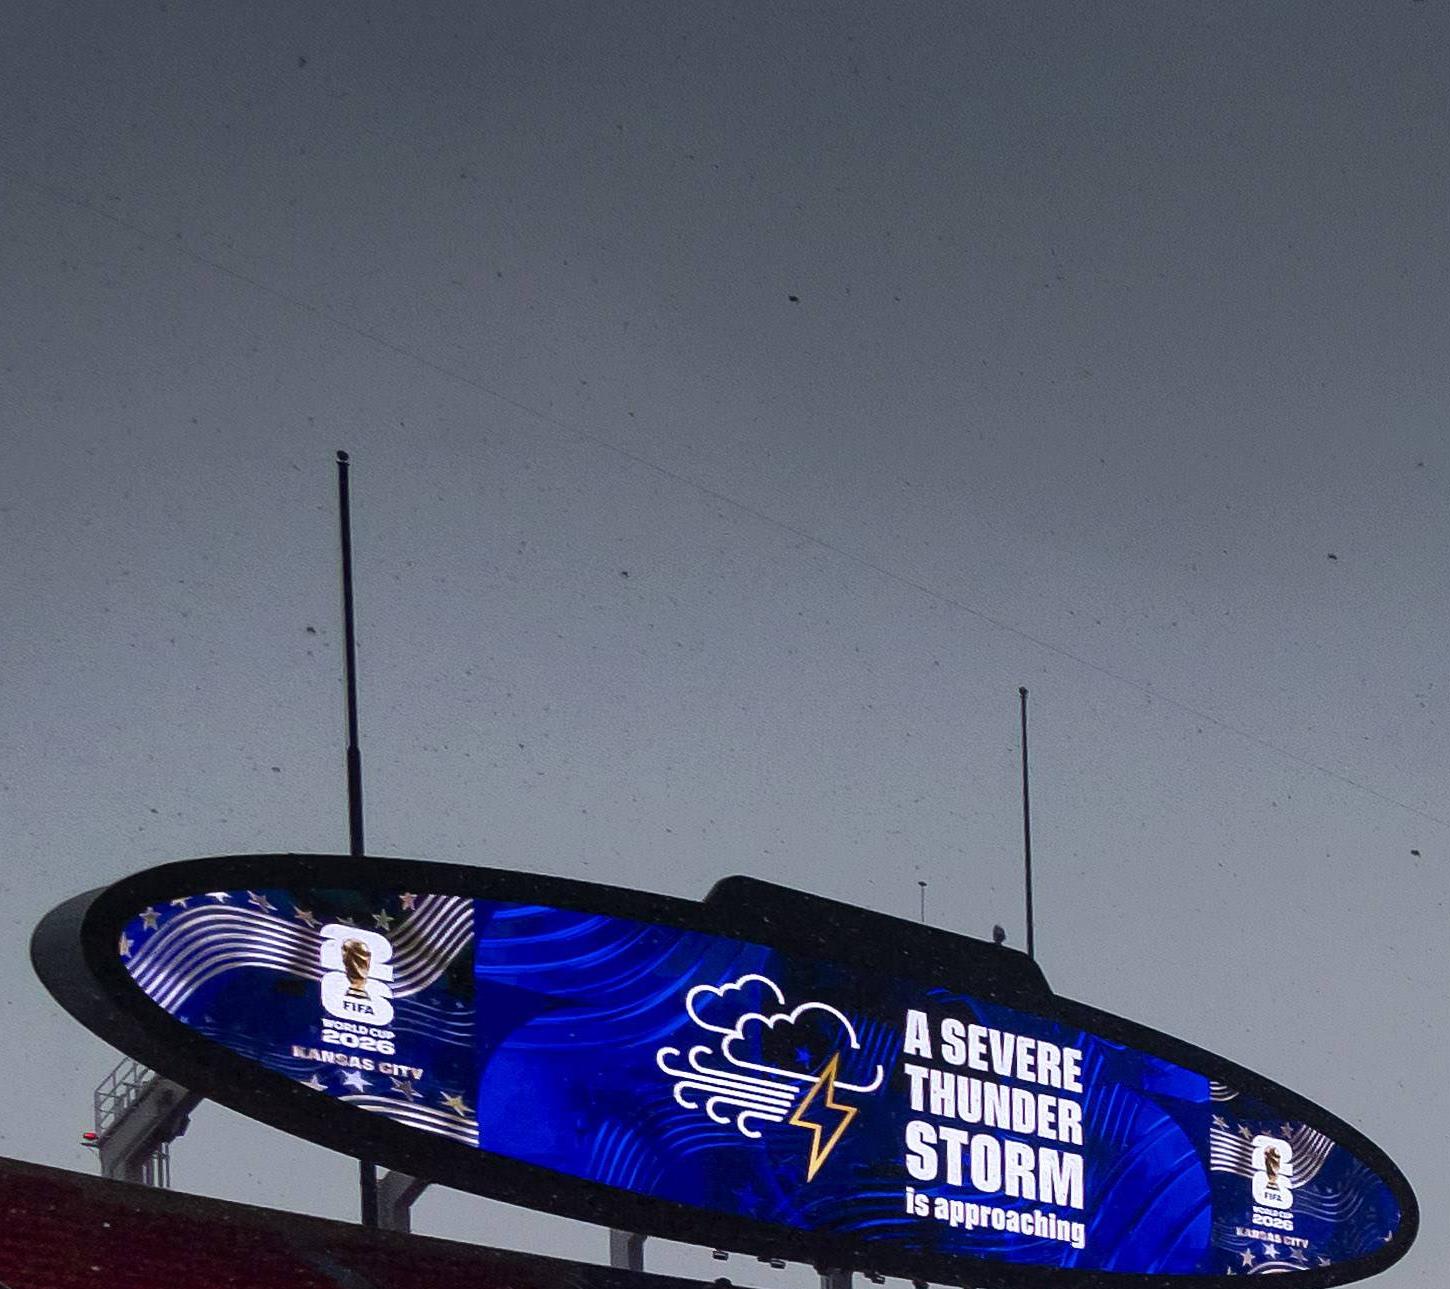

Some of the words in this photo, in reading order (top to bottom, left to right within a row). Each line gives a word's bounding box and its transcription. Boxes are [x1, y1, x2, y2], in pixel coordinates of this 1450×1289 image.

[343, 1000, 375, 1016] FIFA
[321, 1018, 369, 1036] WORLD
[369, 1026, 396, 1040] CUP
[321, 1029, 396, 1055] 2026
[291, 1045, 375, 1071] KANSAS
[378, 1062, 424, 1080] CITY
[903, 1009, 933, 1059] A
[940, 1018, 1083, 1093] SEVERE
[904, 1063, 1083, 1145] THUNDER
[905, 1120, 1084, 1210] STORM
[905, 1186, 930, 1217] is
[934, 1196, 1085, 1249] approaching
[1252, 1213, 1294, 1231] 2026
